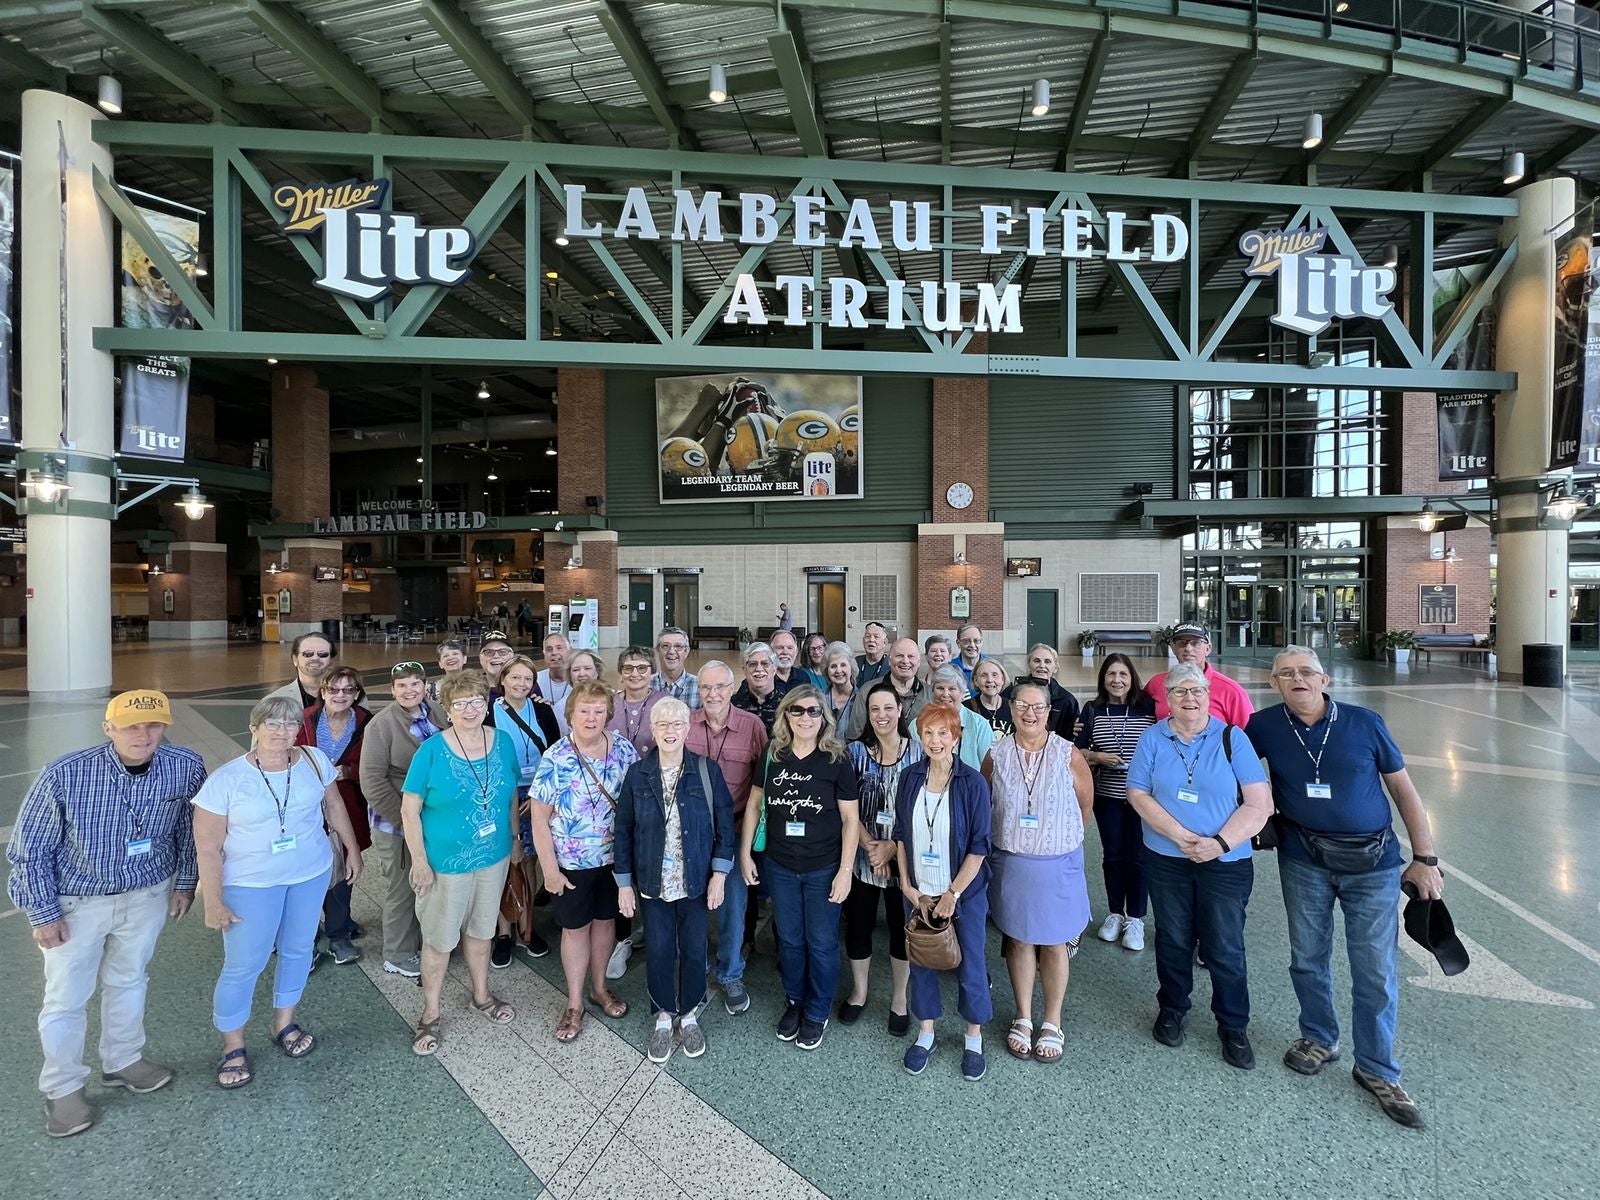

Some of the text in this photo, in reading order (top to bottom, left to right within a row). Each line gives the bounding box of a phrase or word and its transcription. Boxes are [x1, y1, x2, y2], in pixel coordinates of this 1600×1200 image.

[274, 184, 379, 230] Miller
[563, 184, 1189, 263] LAMBEAU FIELD
[315, 208, 470, 298] Lite
[1243, 231, 1324, 273] Miller
[1272, 253, 1394, 332] Lite
[723, 273, 1024, 334] ATRIUM
[137, 364, 176, 377] GREATS
[146, 358, 167, 368] THE
[1460, 399, 1483, 407] BORN
[137, 429, 180, 450] Lite
[1556, 440, 1577, 460] Lite
[807, 460, 832, 478] Lite
[1451, 455, 1487, 472] Lite
[681, 474, 762, 485] LEGENDARY TEAM
[720, 482, 799, 492] LEGENDARY BEER
[361, 499, 432, 511] WELCOME TO
[313, 511, 487, 533] LAMBEAU FIELD
[784, 783, 798, 795] is
